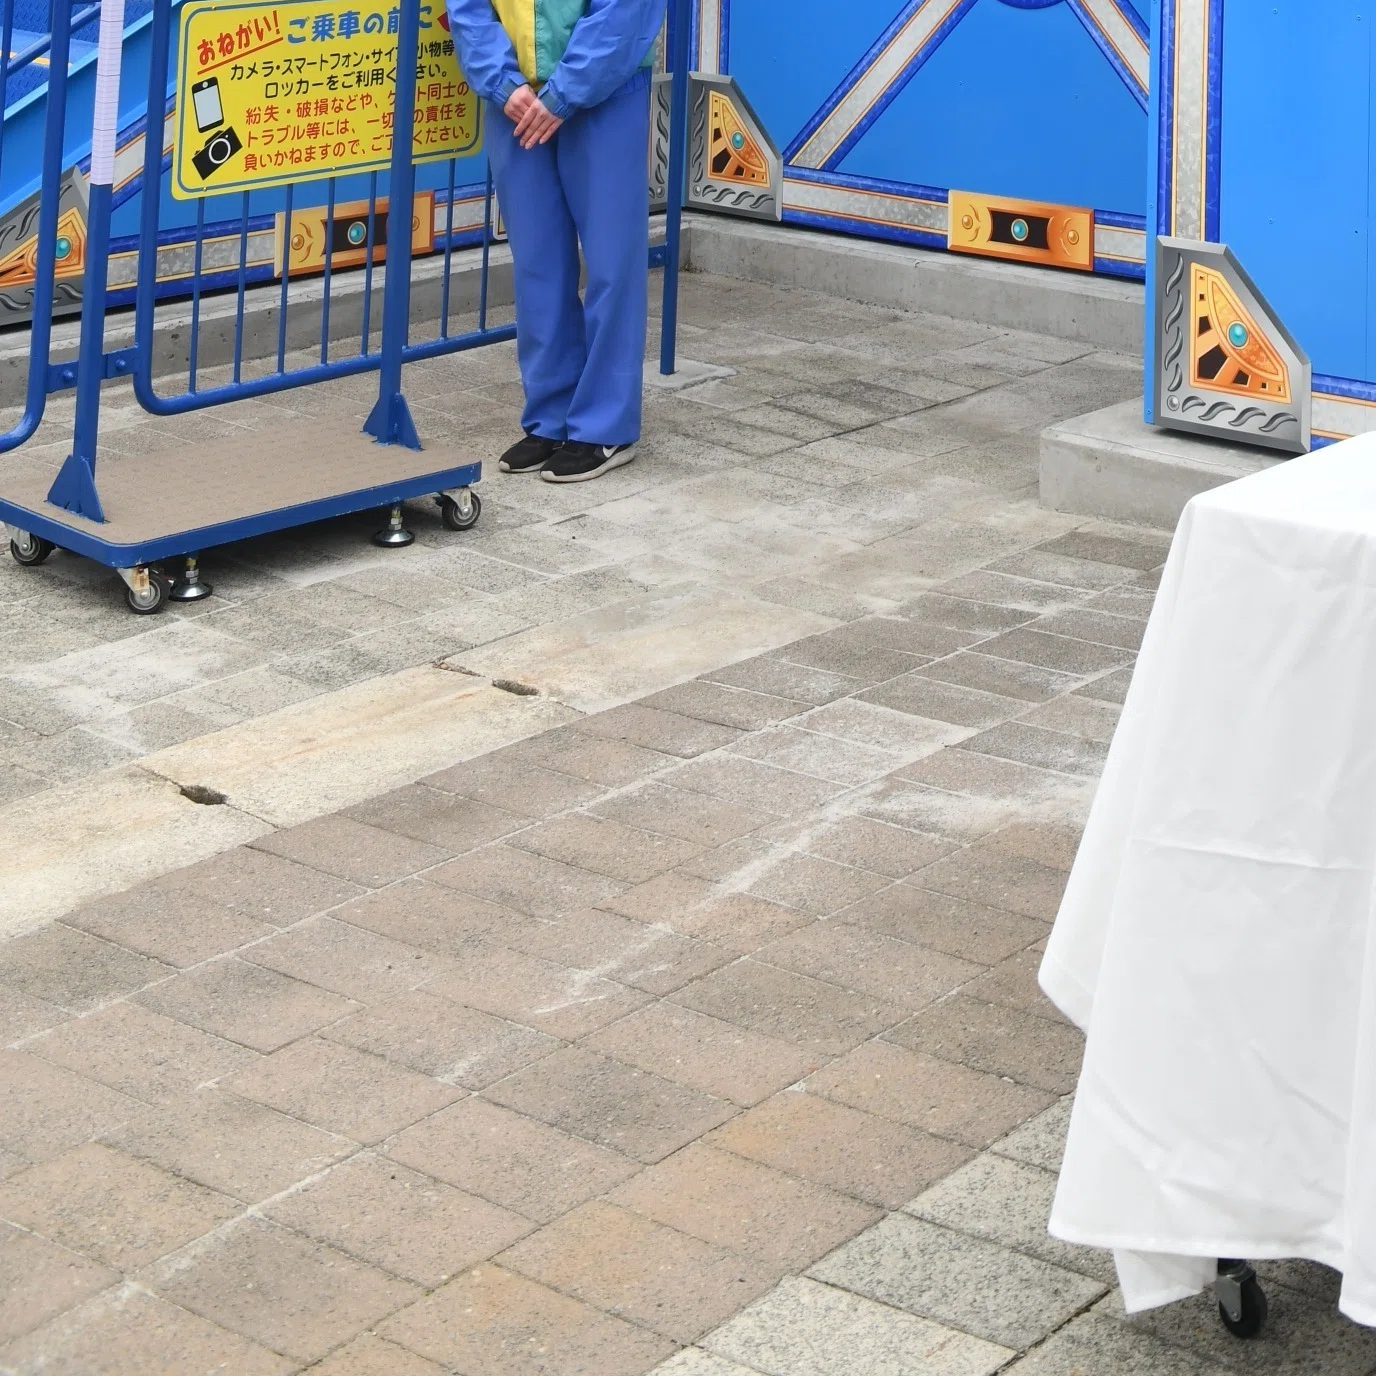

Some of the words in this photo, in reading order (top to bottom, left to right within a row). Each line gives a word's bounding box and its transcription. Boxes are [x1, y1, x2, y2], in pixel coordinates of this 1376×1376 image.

[230, 39, 455, 81] カメラ・スマートフォン・サイ小物等
[265, 63, 448, 98] ロッカーをご利用くさい。
[245, 81, 470, 126] 紛失・破損などや、ト同士の
[247, 102, 467, 148] トラブル等には、一切の責任を
[243, 126, 471, 172] 負いかねますので、ご了ください。
